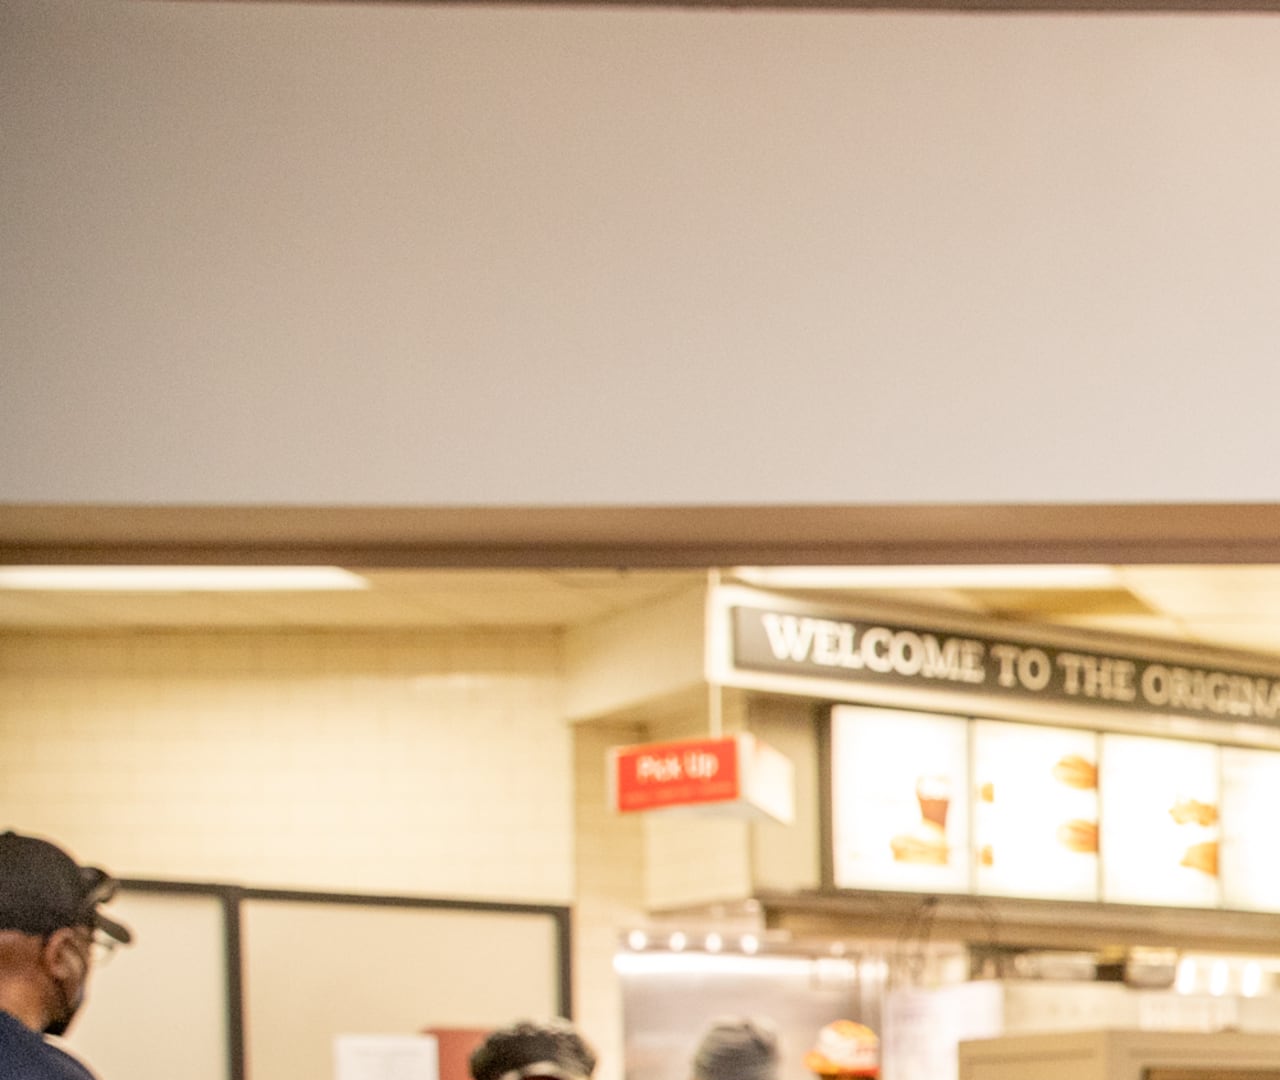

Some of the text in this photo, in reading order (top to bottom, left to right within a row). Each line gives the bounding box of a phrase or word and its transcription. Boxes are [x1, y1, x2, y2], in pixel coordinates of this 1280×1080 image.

[763, 612, 986, 683] WELCOME
[993, 645, 1052, 690] TO
[1056, 652, 1136, 700] THE
